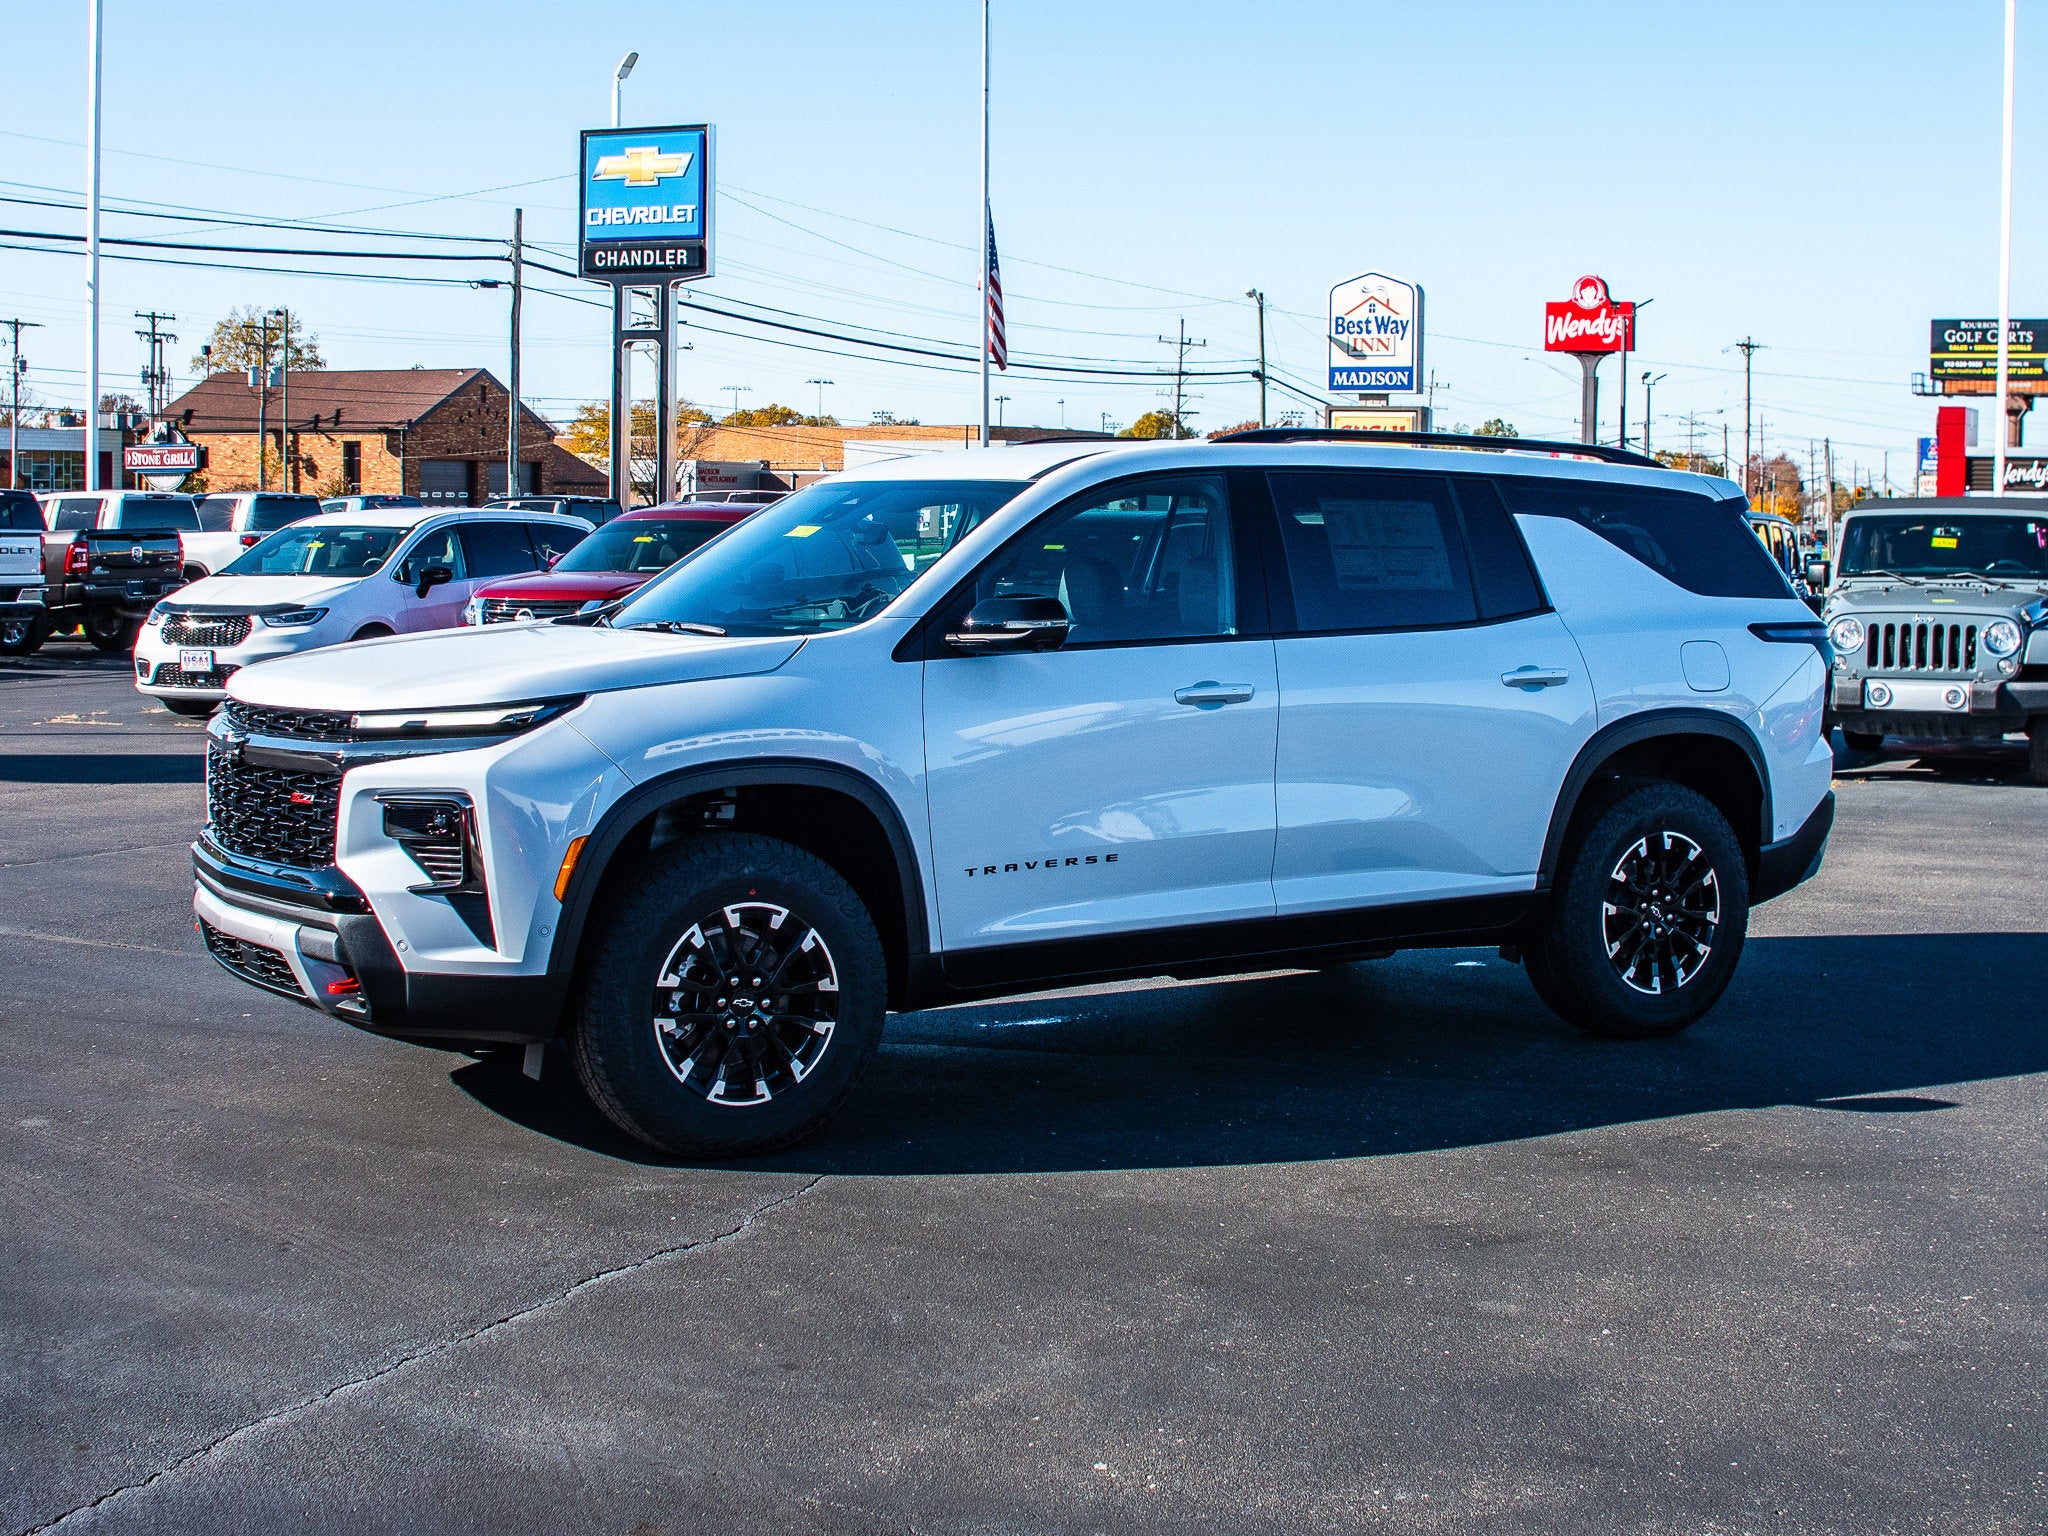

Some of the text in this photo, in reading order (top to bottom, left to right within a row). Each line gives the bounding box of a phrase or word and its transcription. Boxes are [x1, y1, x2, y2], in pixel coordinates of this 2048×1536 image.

[586, 204, 697, 226] CHEVROLET
[594, 249, 688, 268] CHANDLER
[1335, 315, 1409, 340] Best Way
[1547, 308, 1629, 344] Wendy's
[1944, 329, 2034, 343] GOLF CRTS
[1352, 337, 1391, 352] INN
[1333, 371, 1409, 386] MADISON
[131, 451, 191, 466] STONE GRILL
[2003, 460, 2048, 488] endy
[964, 853, 1119, 878] TRAVERSE
